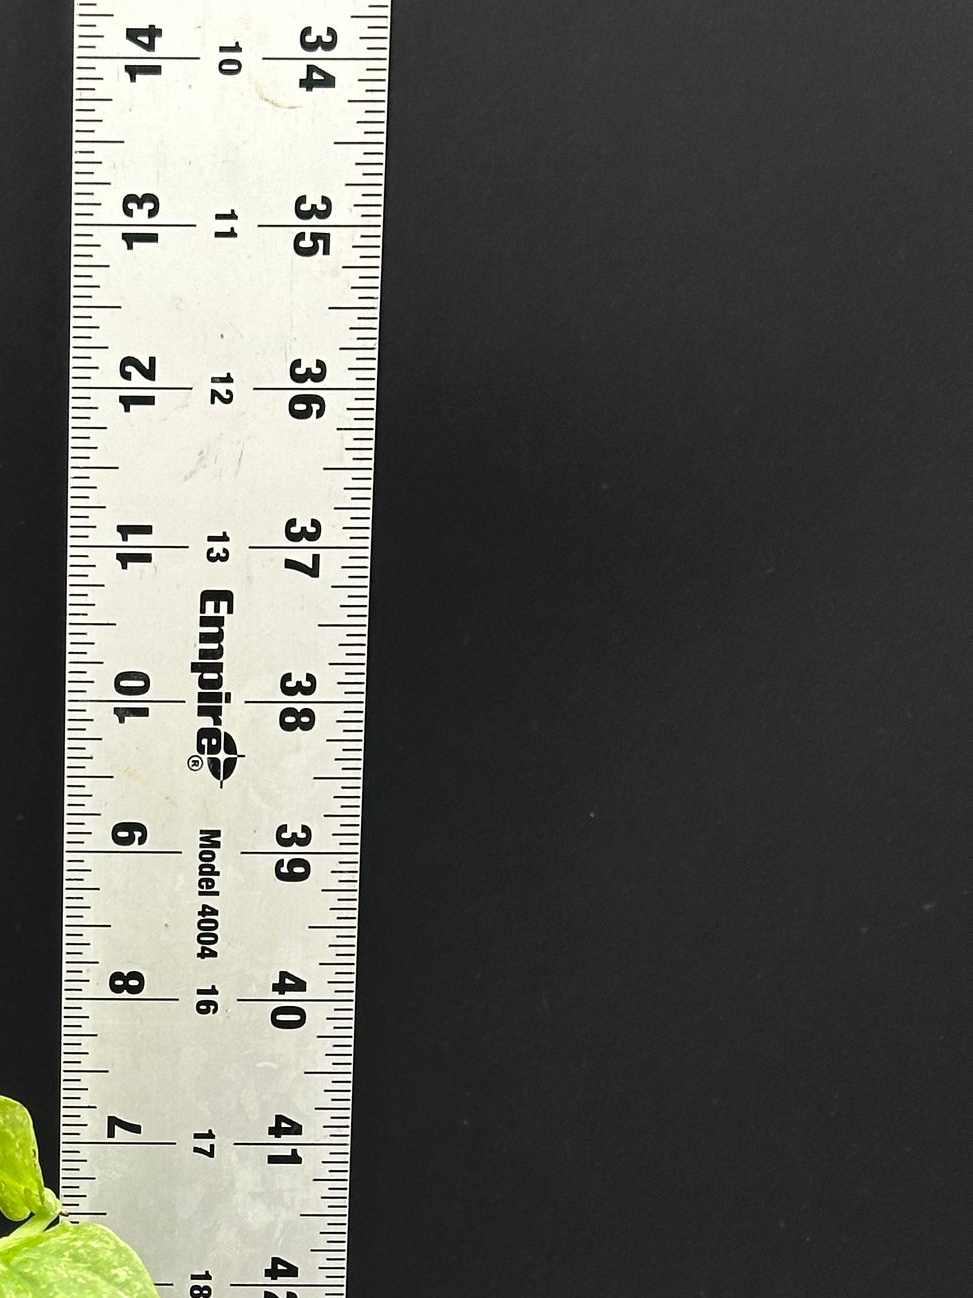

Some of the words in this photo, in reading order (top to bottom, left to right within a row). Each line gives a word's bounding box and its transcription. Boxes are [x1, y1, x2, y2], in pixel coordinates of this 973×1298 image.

[123, 24, 163, 84] 14
[217, 40, 243, 76] 10
[298, 25, 338, 93] 34
[121, 192, 160, 251] 13
[214, 208, 239, 239] 11
[292, 194, 333, 258] 35
[118, 355, 157, 413] 12
[210, 371, 235, 405] 12
[288, 358, 327, 420] 36
[115, 524, 153, 571] 11
[205, 531, 231, 563] 13
[283, 517, 322, 579] 37
[113, 670, 151, 725] 10
[190, 589, 235, 756] Empire
[278, 672, 317, 733] 38
[110, 821, 148, 847] 9
[274, 823, 313, 883] 39
[196, 829, 222, 897] Model
[195, 903, 219, 960] 4004
[108, 970, 145, 995] 8
[195, 984, 219, 1016] 16
[270, 970, 307, 1030] 40
[106, 1115, 142, 1139] 7
[192, 1128, 216, 1159] 17
[267, 1114, 303, 1165] 41
